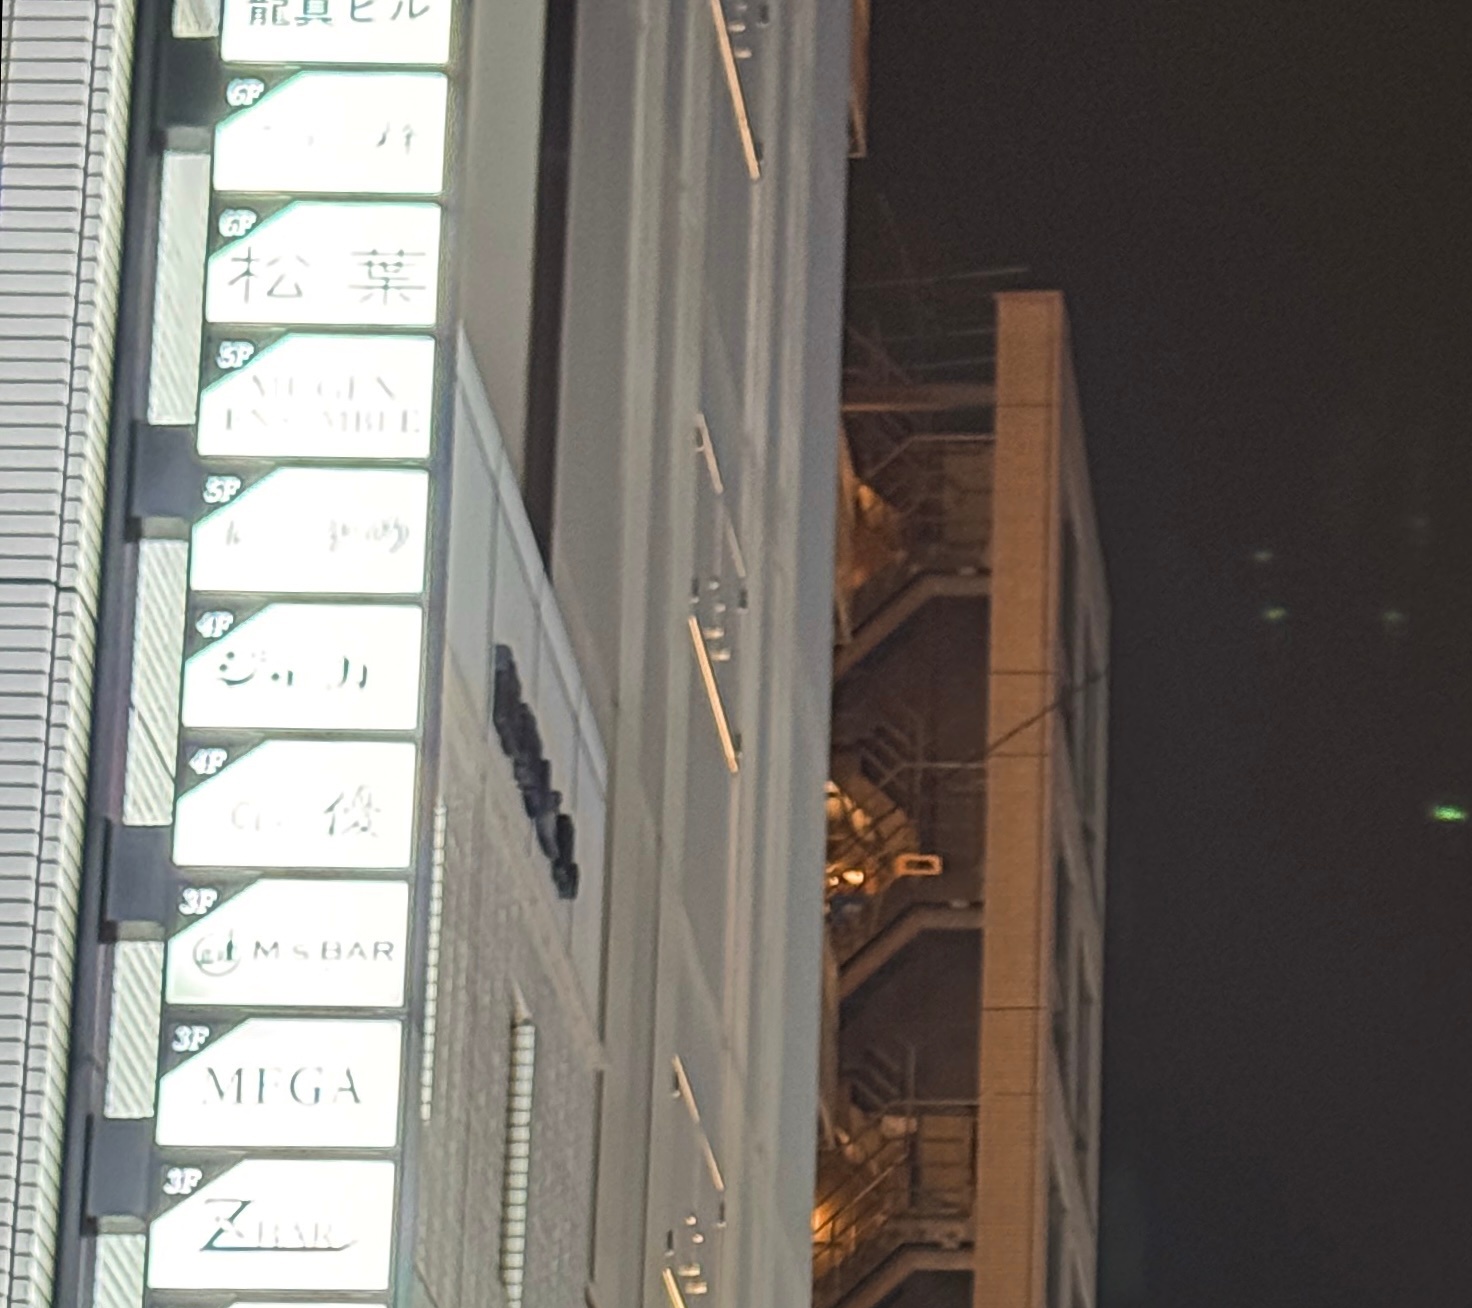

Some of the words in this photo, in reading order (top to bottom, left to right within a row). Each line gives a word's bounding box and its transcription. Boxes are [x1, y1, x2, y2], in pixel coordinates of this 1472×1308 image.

[180, 889, 216, 914] 3F
[320, 940, 395, 962] BAR
[174, 1027, 209, 1051] 3F
[164, 1168, 201, 1194] 3F
